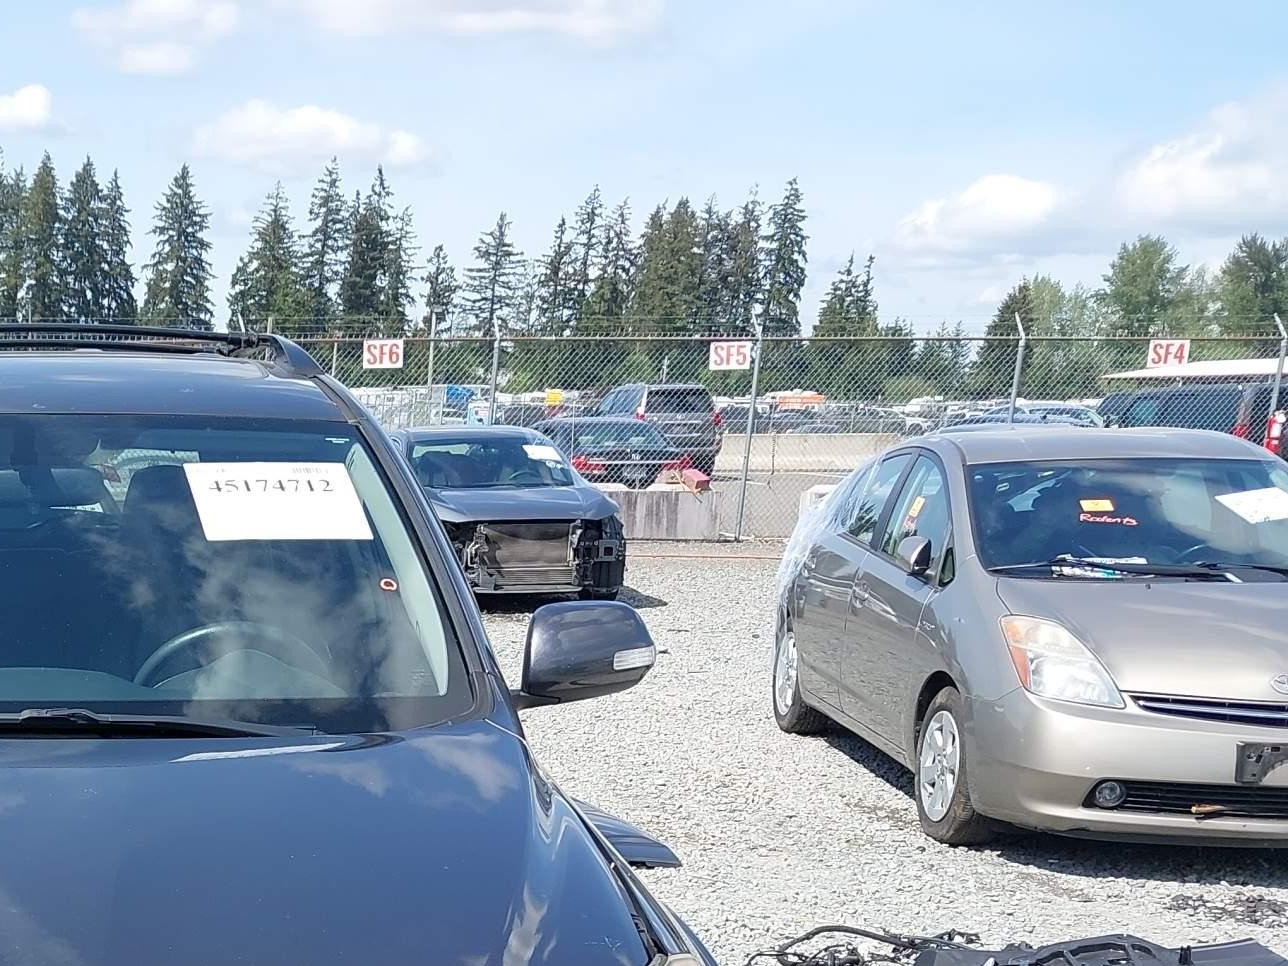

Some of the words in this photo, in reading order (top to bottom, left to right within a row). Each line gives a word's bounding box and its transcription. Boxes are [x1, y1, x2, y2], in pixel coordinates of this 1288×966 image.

[366, 343, 400, 365] SF6
[714, 344, 747, 366] SF5
[1150, 343, 1186, 364] SF4
[208, 478, 335, 493] 45174712
